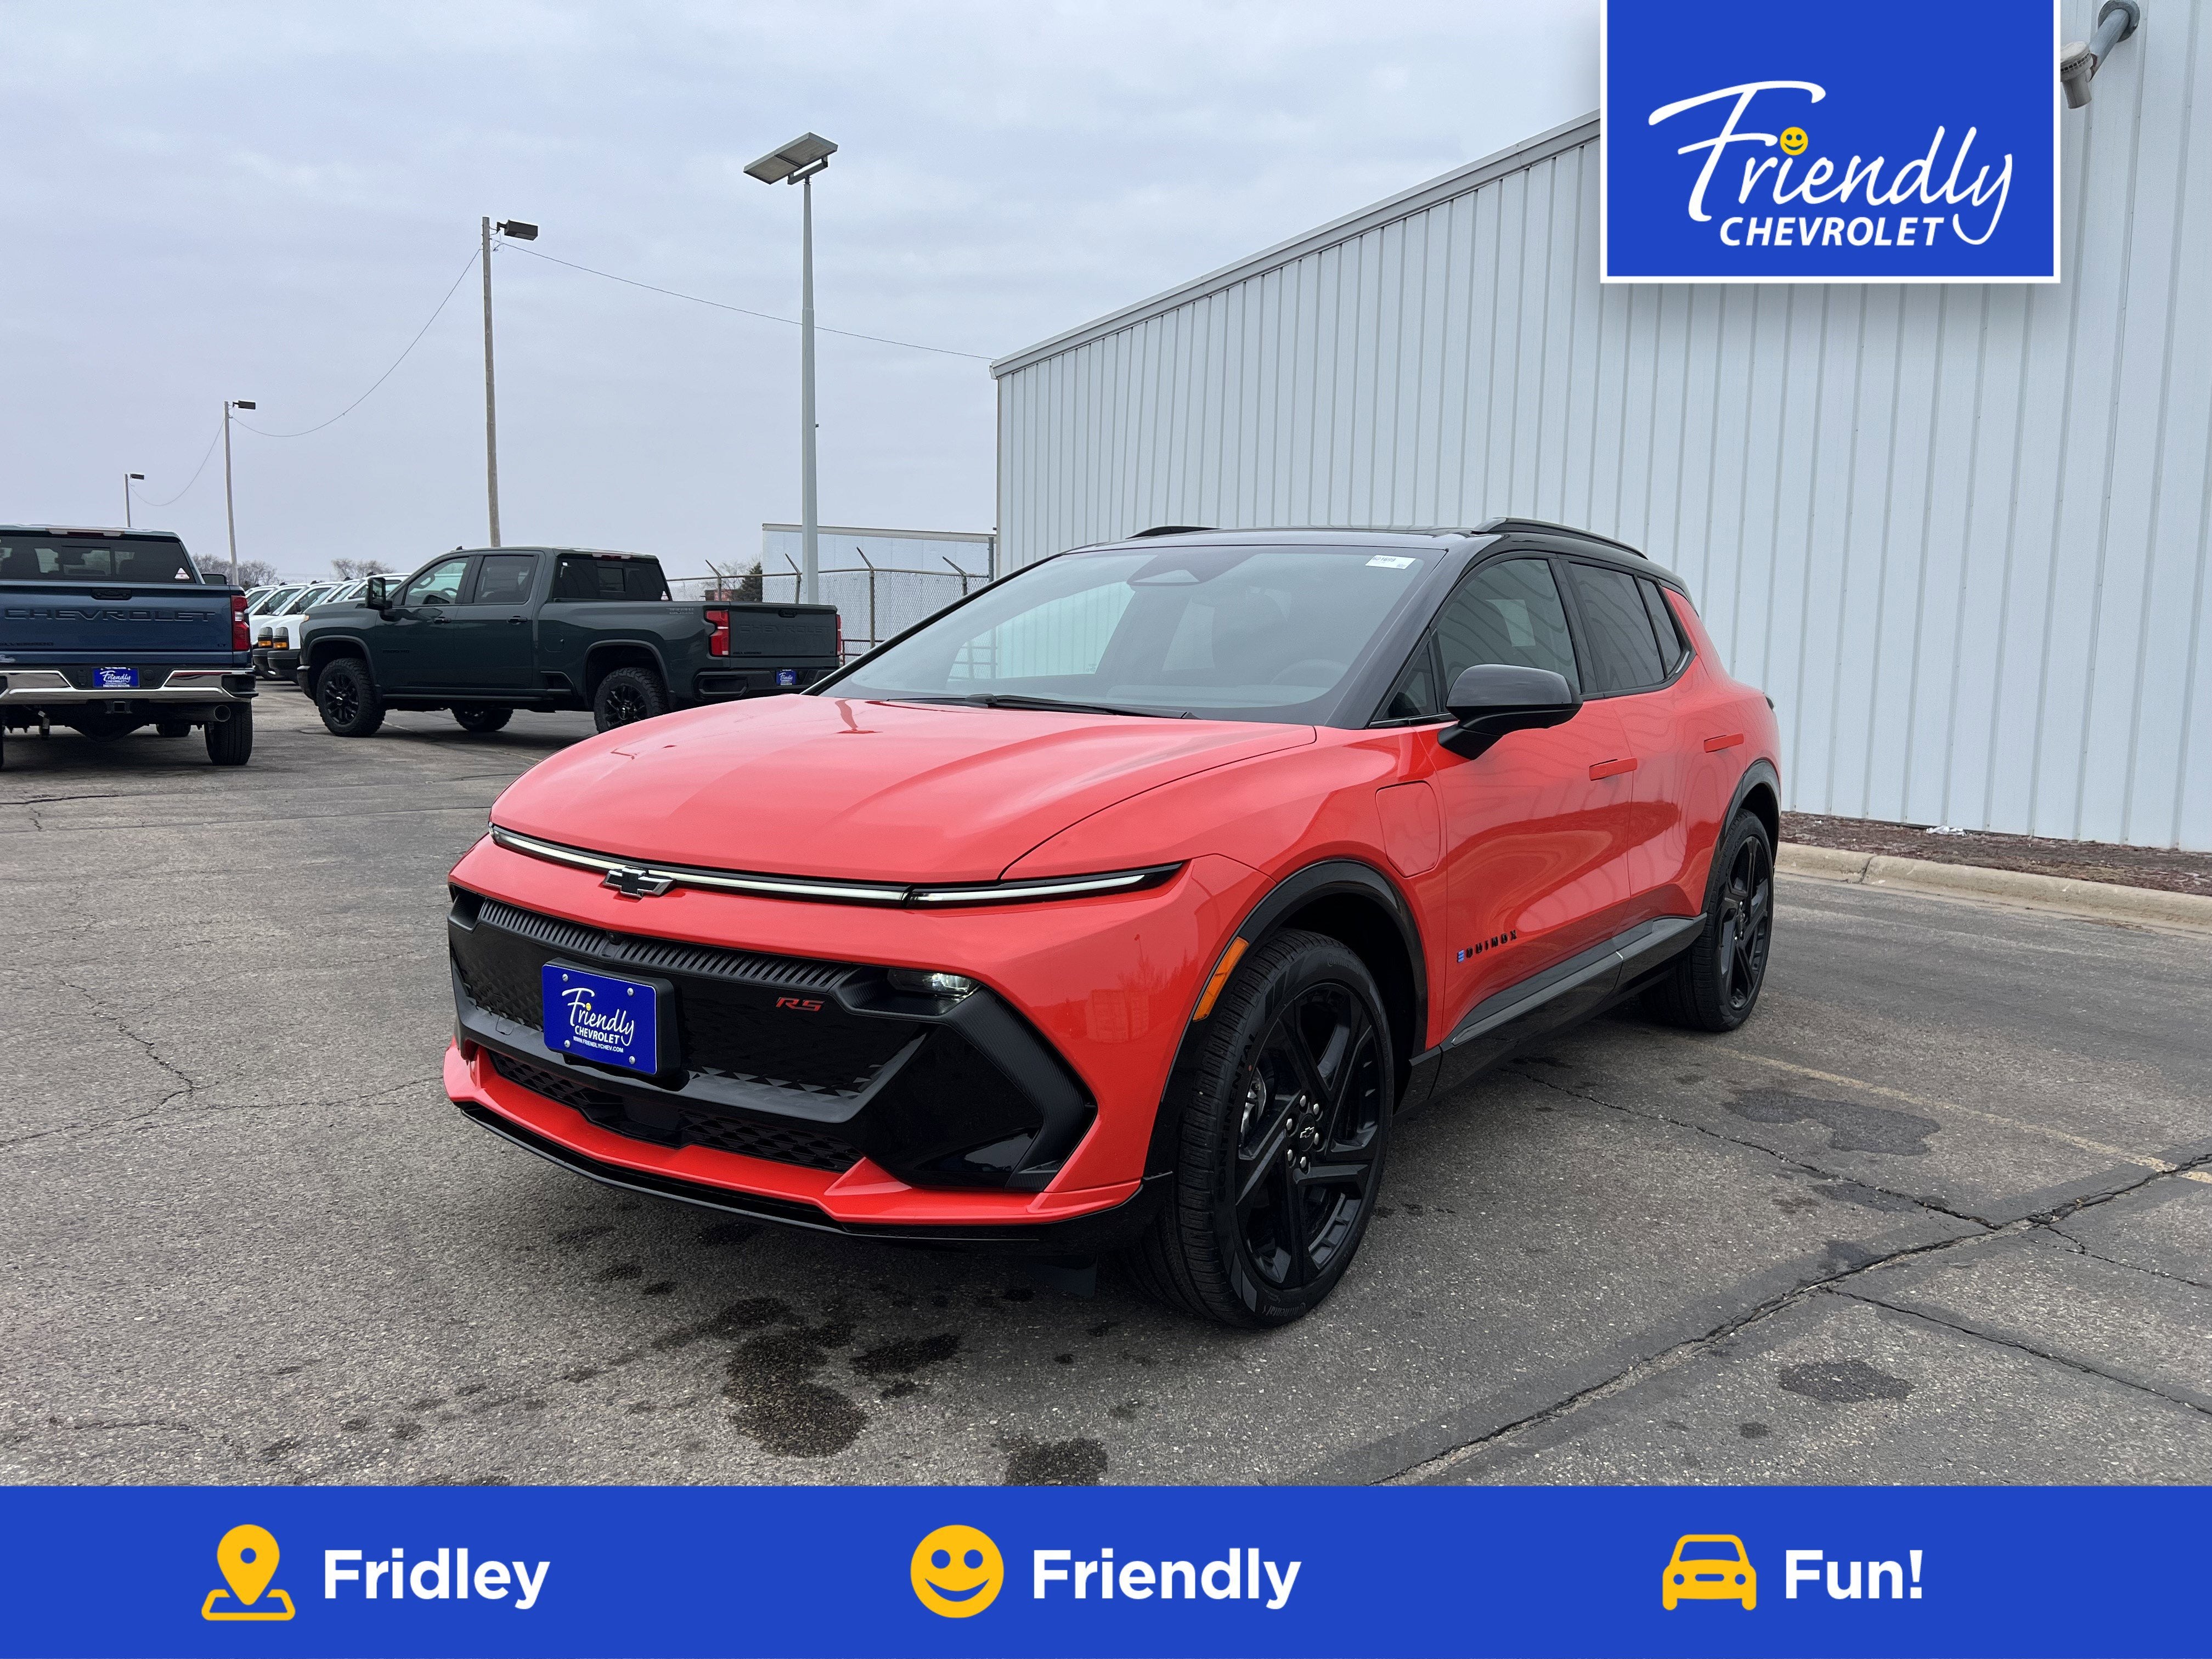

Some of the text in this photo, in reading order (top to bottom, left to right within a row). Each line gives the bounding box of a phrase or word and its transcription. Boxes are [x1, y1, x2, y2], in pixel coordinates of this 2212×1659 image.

[4, 608, 216, 622] CHEVROLET
[740, 624, 831, 634] CHEVROLET
[99, 670, 131, 683] Friendly
[1457, 929, 1517, 963] EQUINOX
[775, 996, 826, 1012] RS
[561, 987, 635, 1046] Friendly
[574, 1025, 620, 1045] CHEVROLET
[573, 1035, 624, 1053] WWW.FRIENDLYCHEV.COM
